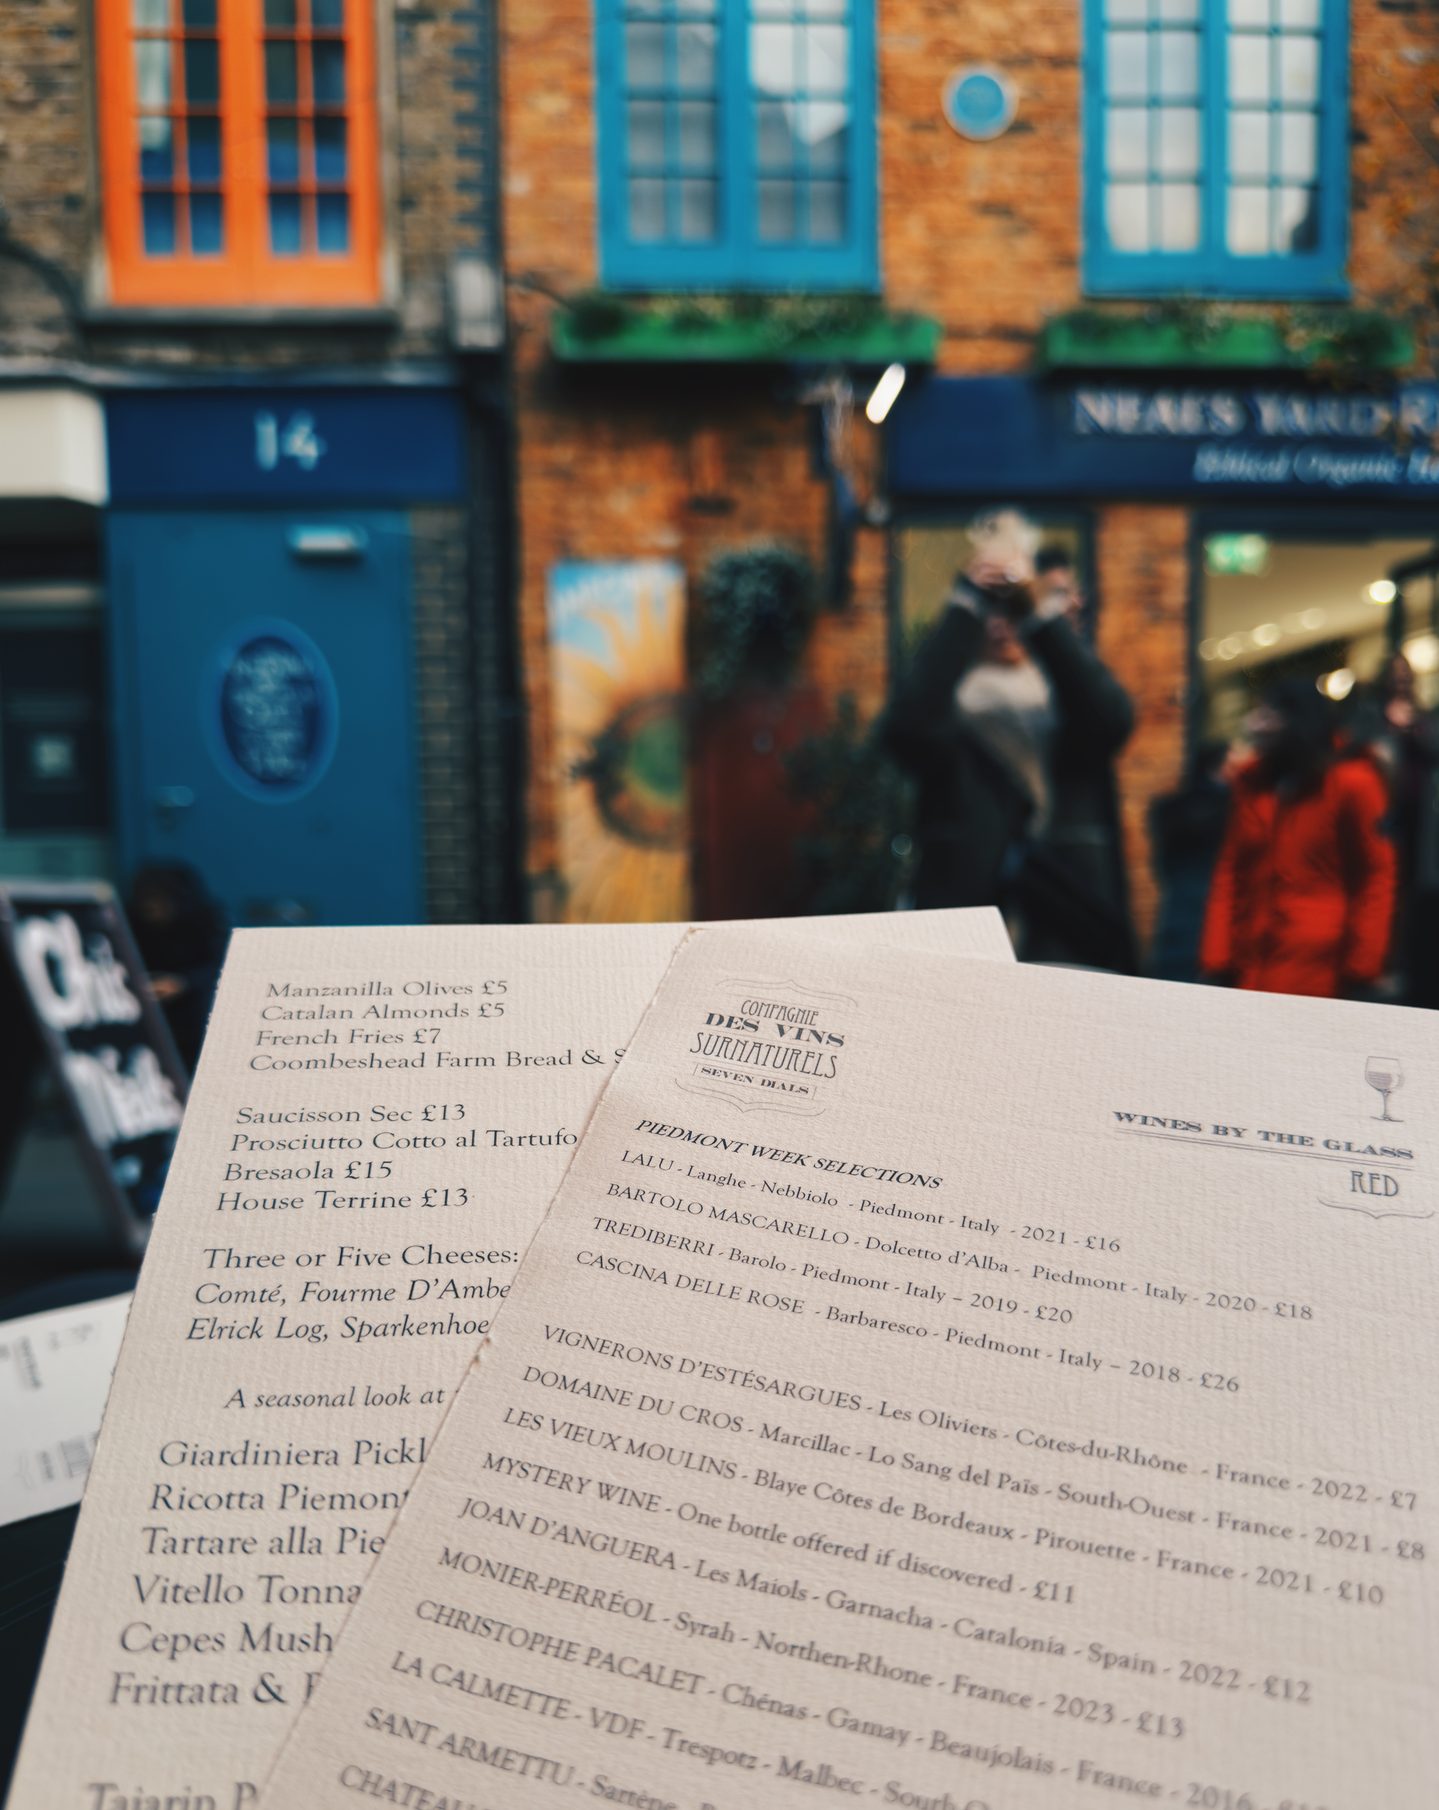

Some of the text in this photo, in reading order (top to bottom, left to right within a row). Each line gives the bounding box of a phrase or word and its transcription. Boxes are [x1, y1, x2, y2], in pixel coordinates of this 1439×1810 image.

[254, 410, 326, 470] 14
[267, 980, 507, 998] Manzanilla Olives £5
[260, 1002, 504, 1021] Catalan Almonds £5
[740, 999, 819, 1026] COMPAGNIE
[256, 1028, 441, 1046] French Fries £7
[704, 1012, 845, 1048] DES VINS
[249, 1052, 425, 1070] Coombeshead
[437, 1051, 495, 1067] Farm
[506, 1049, 572, 1067] Bread
[582, 1050, 605, 1065] &
[690, 1032, 838, 1079] SURNATURELS
[700, 1067, 809, 1095] SEVEN DIALS
[236, 1104, 465, 1124] Saucisson Sec £13
[230, 1127, 577, 1152] Prosciutto Cotto al Tartufo
[1112, 1110, 1414, 1160] WINES BY THE GLASS
[635, 1119, 943, 1188] PIEDMONT WEEK SELECTIONS
[223, 1160, 392, 1181] Bresaola £15
[1349, 1170, 1399, 1198] RED
[216, 1188, 468, 1211] House Terrine £13
[621, 1150, 1120, 1252] LALU Langhe Nebbiolo Piedmont Italy 2021 £16
[203, 1243, 518, 1268] Three or Five Cheeses:
[607, 1184, 703, 1215] BARTOLO
[709, 1206, 849, 1244] MASCARELLO
[865, 1236, 941, 1261] Dolcetto
[1032, 1265, 1127, 1292] Piedmont
[1145, 1282, 1188, 1305] Italy
[1206, 1292, 1257, 1312] 2020
[1274, 1302, 1313, 1320] £18
[594, 1217, 1073, 1324] TREDIBERRI Barolo Piedmont Italy 2019 £20
[195, 1283, 285, 1306] Comté,
[299, 1282, 396, 1302] Fourme
[186, 1314, 490, 1343] Elrick Log, Sparkenhoe
[577, 1251, 1240, 1393] CASCINA DELLE ROSE Barbaresco Piedmont Italy 2018 £26
[223, 1385, 445, 1408] A seasonal look at
[545, 1325, 673, 1370] VIGNERONS
[878, 1401, 911, 1421] Les
[918, 1409, 997, 1439] Oliviers
[1216, 1463, 1290, 1491] France
[1312, 1477, 1368, 1504] 2022
[1390, 1490, 1417, 1511] £7
[160, 1440, 339, 1467] Giardiniera
[522, 1366, 1426, 1562] DOMAINE DU CROS Marcillac Lo Sang del Païs South-Ouest France 2021 £8
[150, 1484, 264, 1511] Ricotta
[503, 1407, 1385, 1606] LES VIEUX MOULINS Blaye Côtes de Bordeaux Pirouette France 2021 £10
[142, 1527, 257, 1555] Tartare
[269, 1526, 322, 1555] alla
[482, 1453, 1074, 1604] MYSTERY WINE One bottle offered if discovered £11
[133, 1573, 244, 1604] Vitello
[457, 1497, 527, 1529] JOAN
[694, 1559, 730, 1584] Les
[826, 1589, 933, 1630] Garnacha
[953, 1618, 1066, 1657] Catalonia
[1088, 1642, 1157, 1676] Spain
[1179, 1659, 1241, 1691] 2022
[1263, 1675, 1311, 1705] £12
[119, 1622, 225, 1660] Cepes
[674, 1611, 735, 1643] Syrah
[109, 1672, 238, 1705] Frittata
[252, 1672, 288, 1705] &
